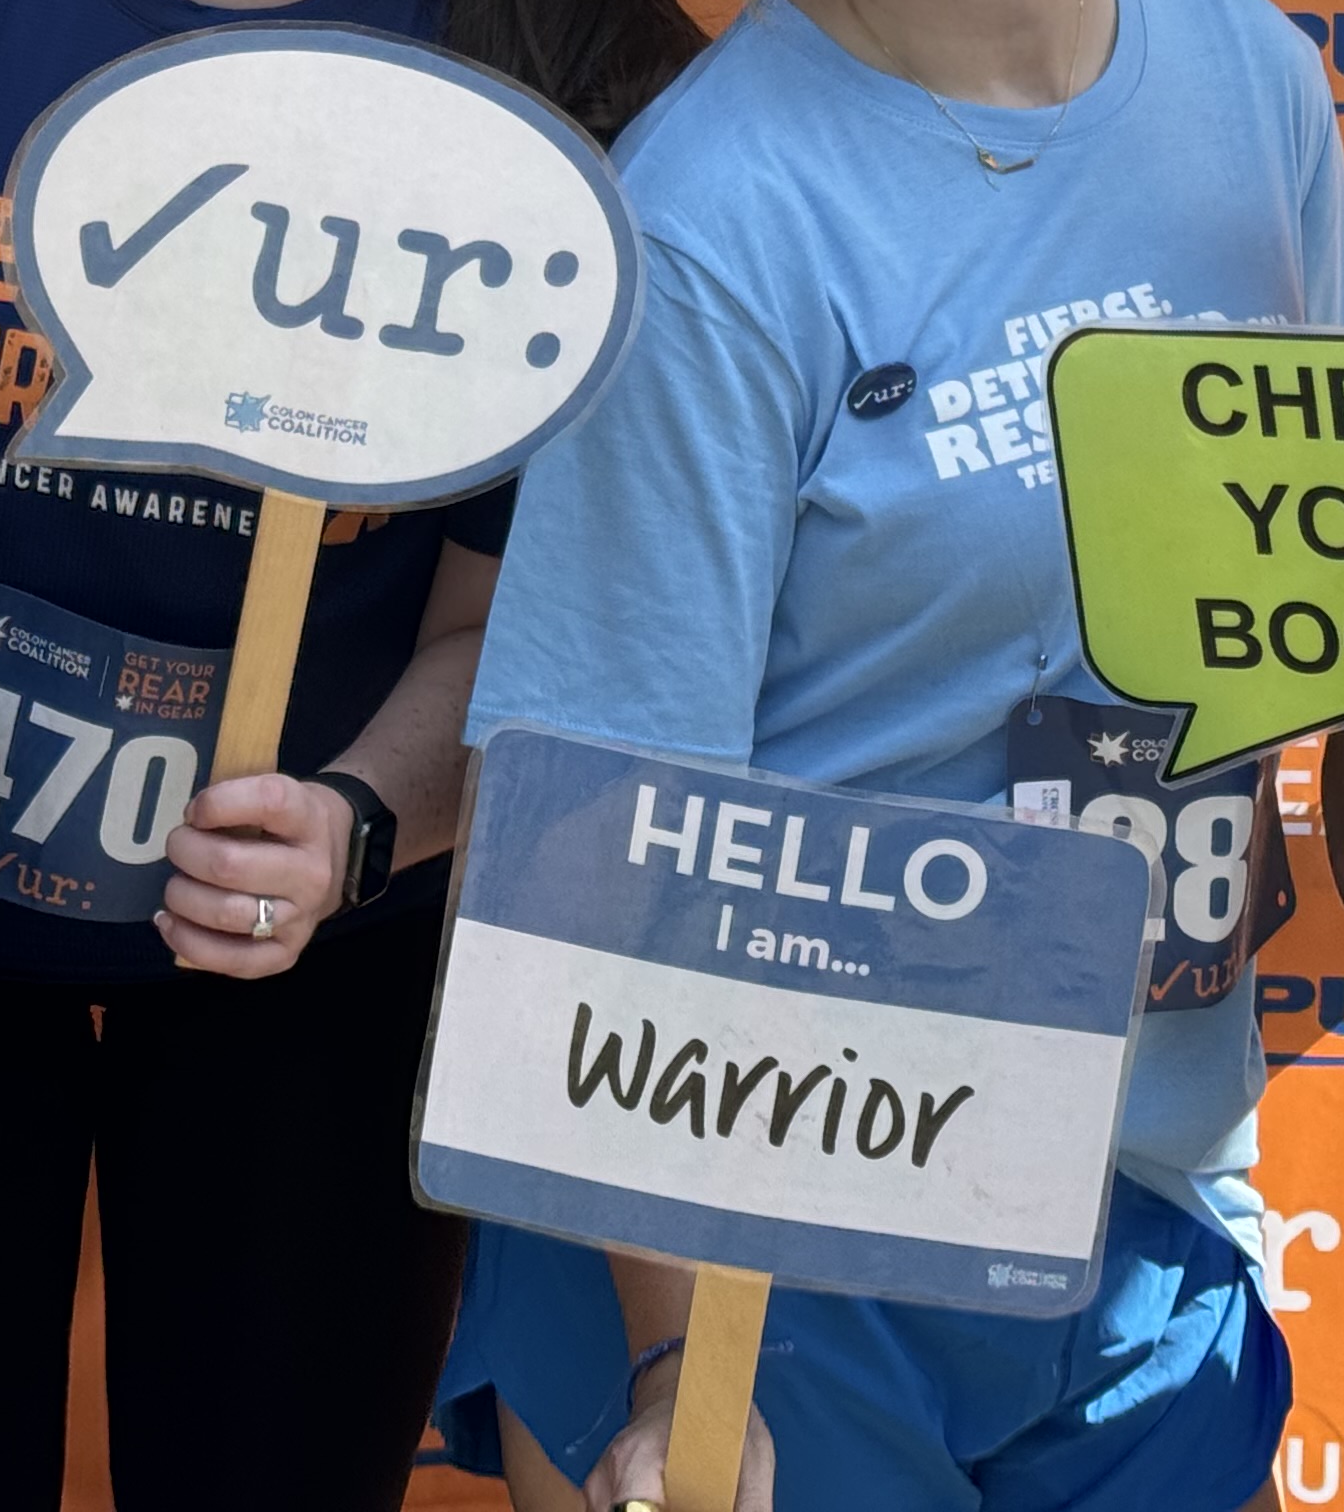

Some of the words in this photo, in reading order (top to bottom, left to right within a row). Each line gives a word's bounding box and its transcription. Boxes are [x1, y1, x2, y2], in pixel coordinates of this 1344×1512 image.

[268, 417, 366, 445] COALITION
[269, 405, 315, 422] COLON
[317, 414, 368, 431] CANCER
[91, 485, 254, 537] AWARENE
[8, 637, 89, 680] COALITION
[10, 627, 47, 648] COLON
[49, 642, 91, 665] CANCER
[125, 652, 160, 670] GET
[166, 661, 215, 678] YOUR
[118, 668, 209, 704] REAR
[135, 699, 154, 714] IN
[157, 704, 204, 720] GEAR
[1132, 738, 1169, 748] COLO
[627, 784, 988, 921] HELLO
[716, 905, 733, 951] I
[745, 925, 870, 977] am...
[567, 1002, 975, 1169] Warrior
